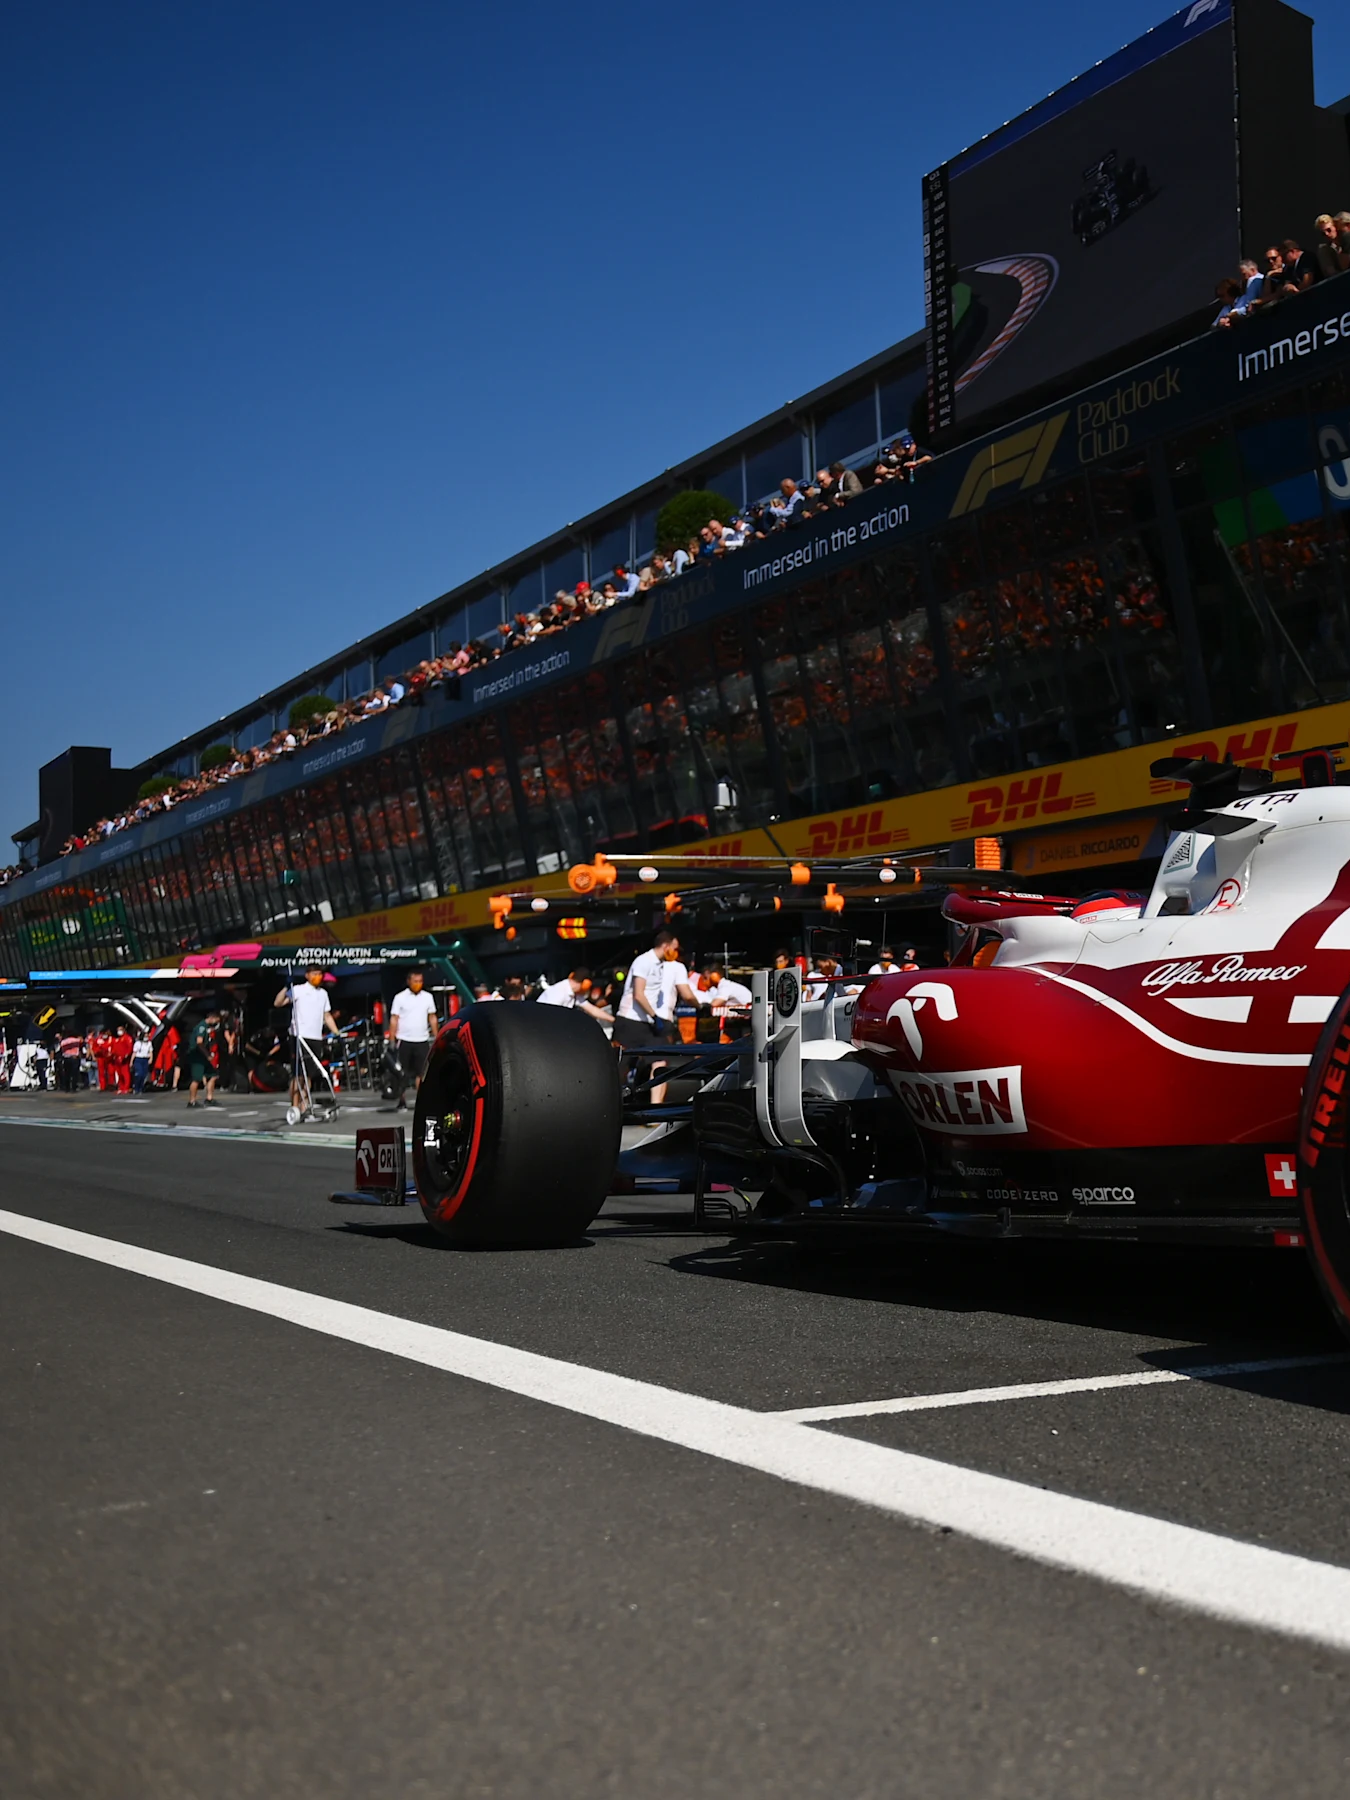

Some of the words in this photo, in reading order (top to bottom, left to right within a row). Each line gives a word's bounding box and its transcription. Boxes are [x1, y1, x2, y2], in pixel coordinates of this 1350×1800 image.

[1077, 364, 1181, 435] Paddock
[1078, 423, 1129, 463] Club
[743, 541, 812, 590] Immersed
[815, 536, 828, 560] in
[830, 527, 857, 553] the
[860, 503, 910, 541] action
[473, 670, 514, 703] Immersed
[515, 668, 524, 686] in
[525, 663, 540, 682] the
[541, 651, 570, 675] action
[967, 773, 1073, 828] DHL
[808, 810, 892, 857] DHL
[1040, 846, 1079, 862] DANIEL
[1081, 835, 1140, 857] RICCIARDO
[420, 901, 460, 931] DHL
[296, 947, 331, 958] ASTON
[333, 947, 371, 958] MARTIN
[379, 948, 417, 959] Cognizant
[1141, 960, 1206, 996] Alfa
[1203, 953, 1307, 983] Romeo
[900, 1077, 1014, 1125] ORLEN
[380, 1148, 397, 1168] ORL
[1072, 1186, 1135, 1206] sparco
